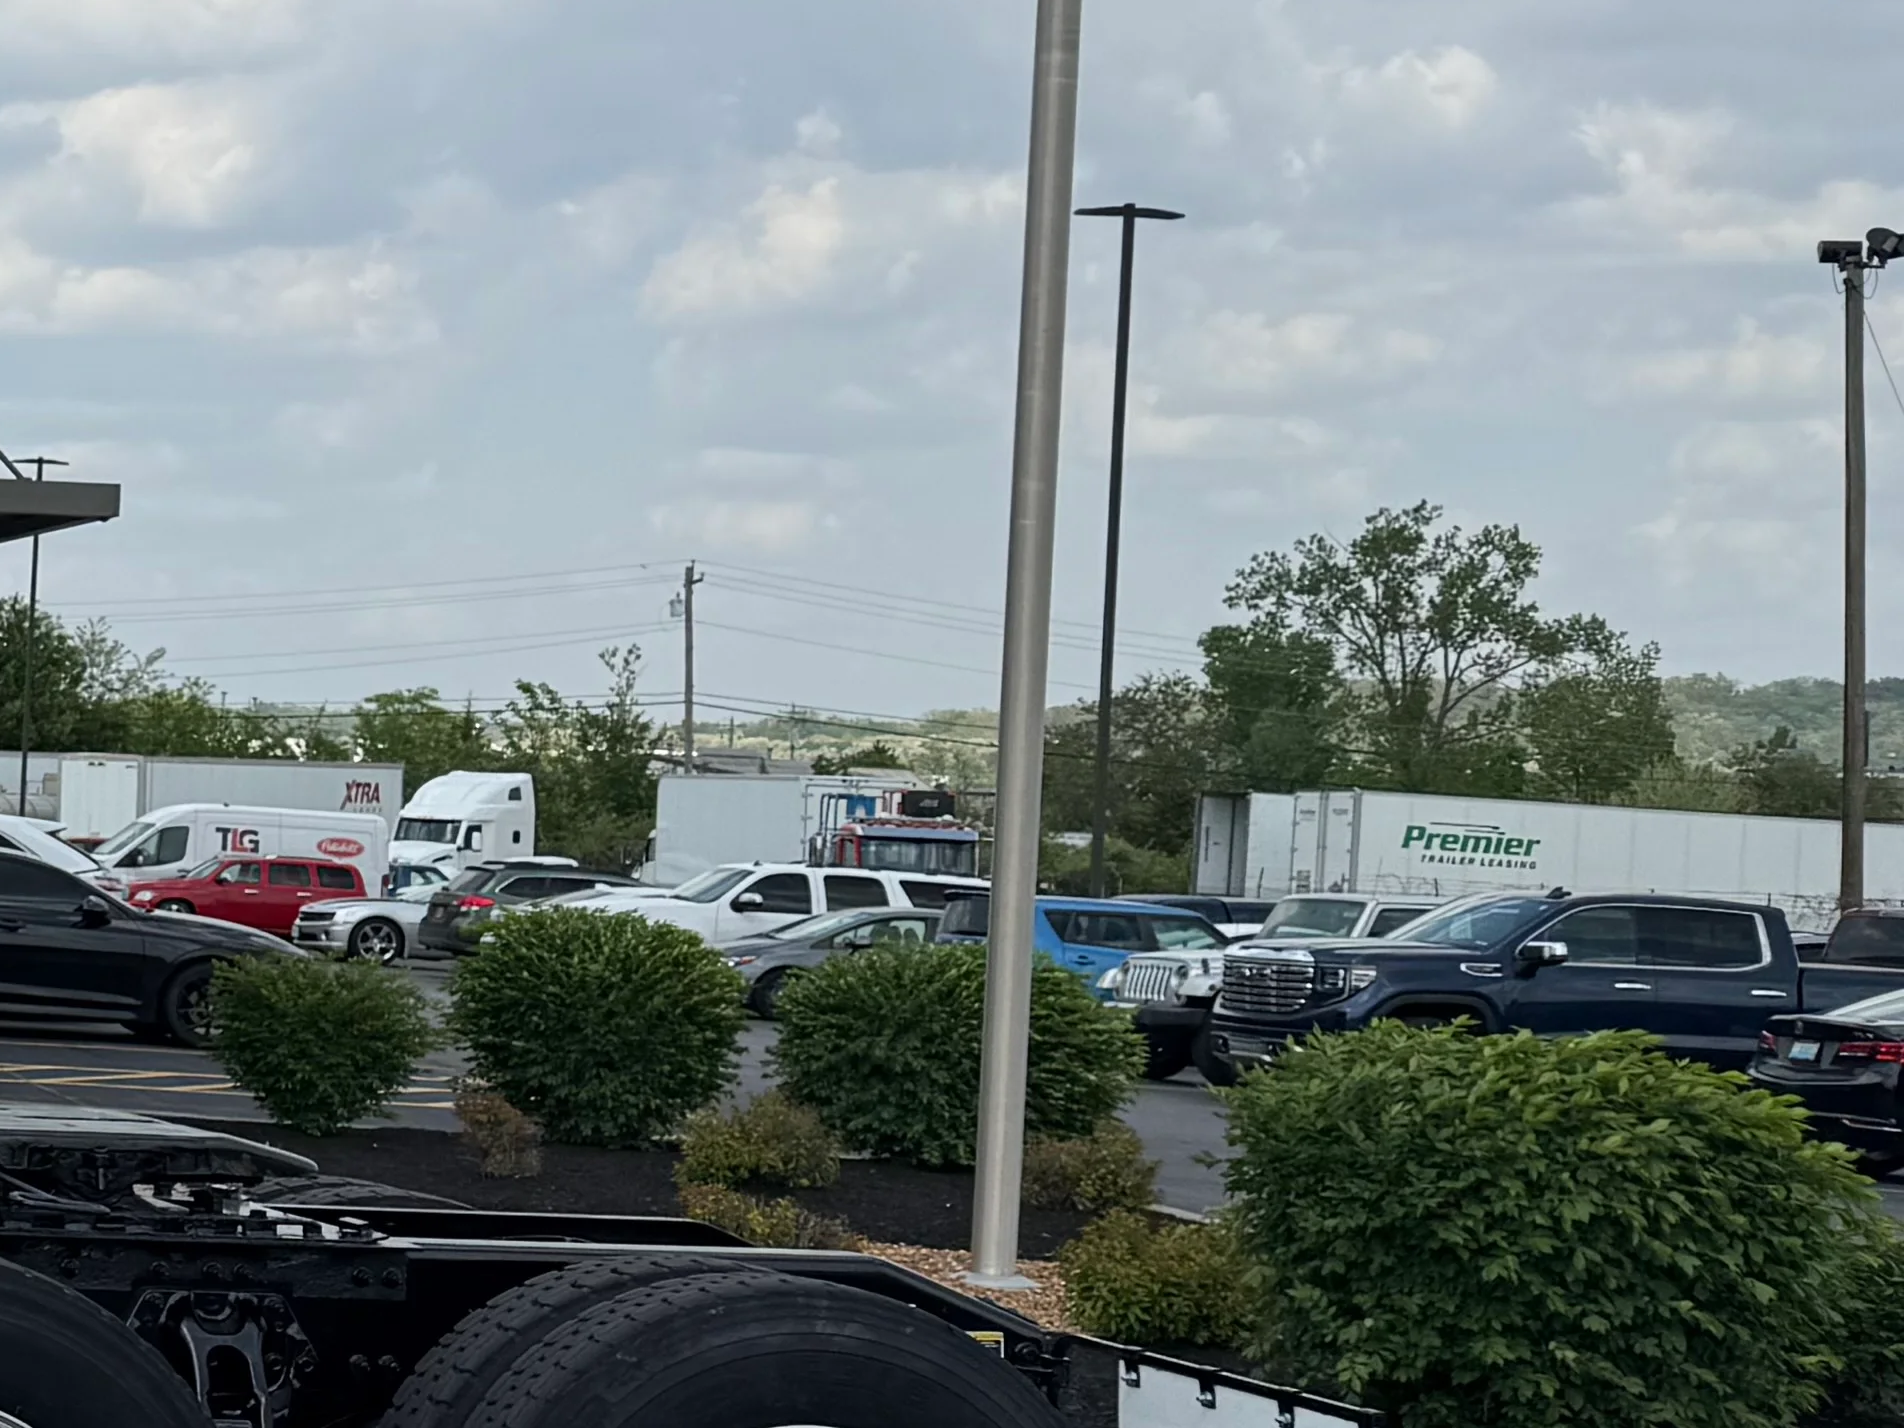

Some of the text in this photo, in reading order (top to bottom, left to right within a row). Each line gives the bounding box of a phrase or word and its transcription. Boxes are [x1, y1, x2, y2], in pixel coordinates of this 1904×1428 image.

[340, 780, 380, 810] XTRA
[215, 827, 260, 853] TLG
[1401, 825, 1541, 857] Premier
[1421, 854, 1537, 870] TRAILER LEASING
